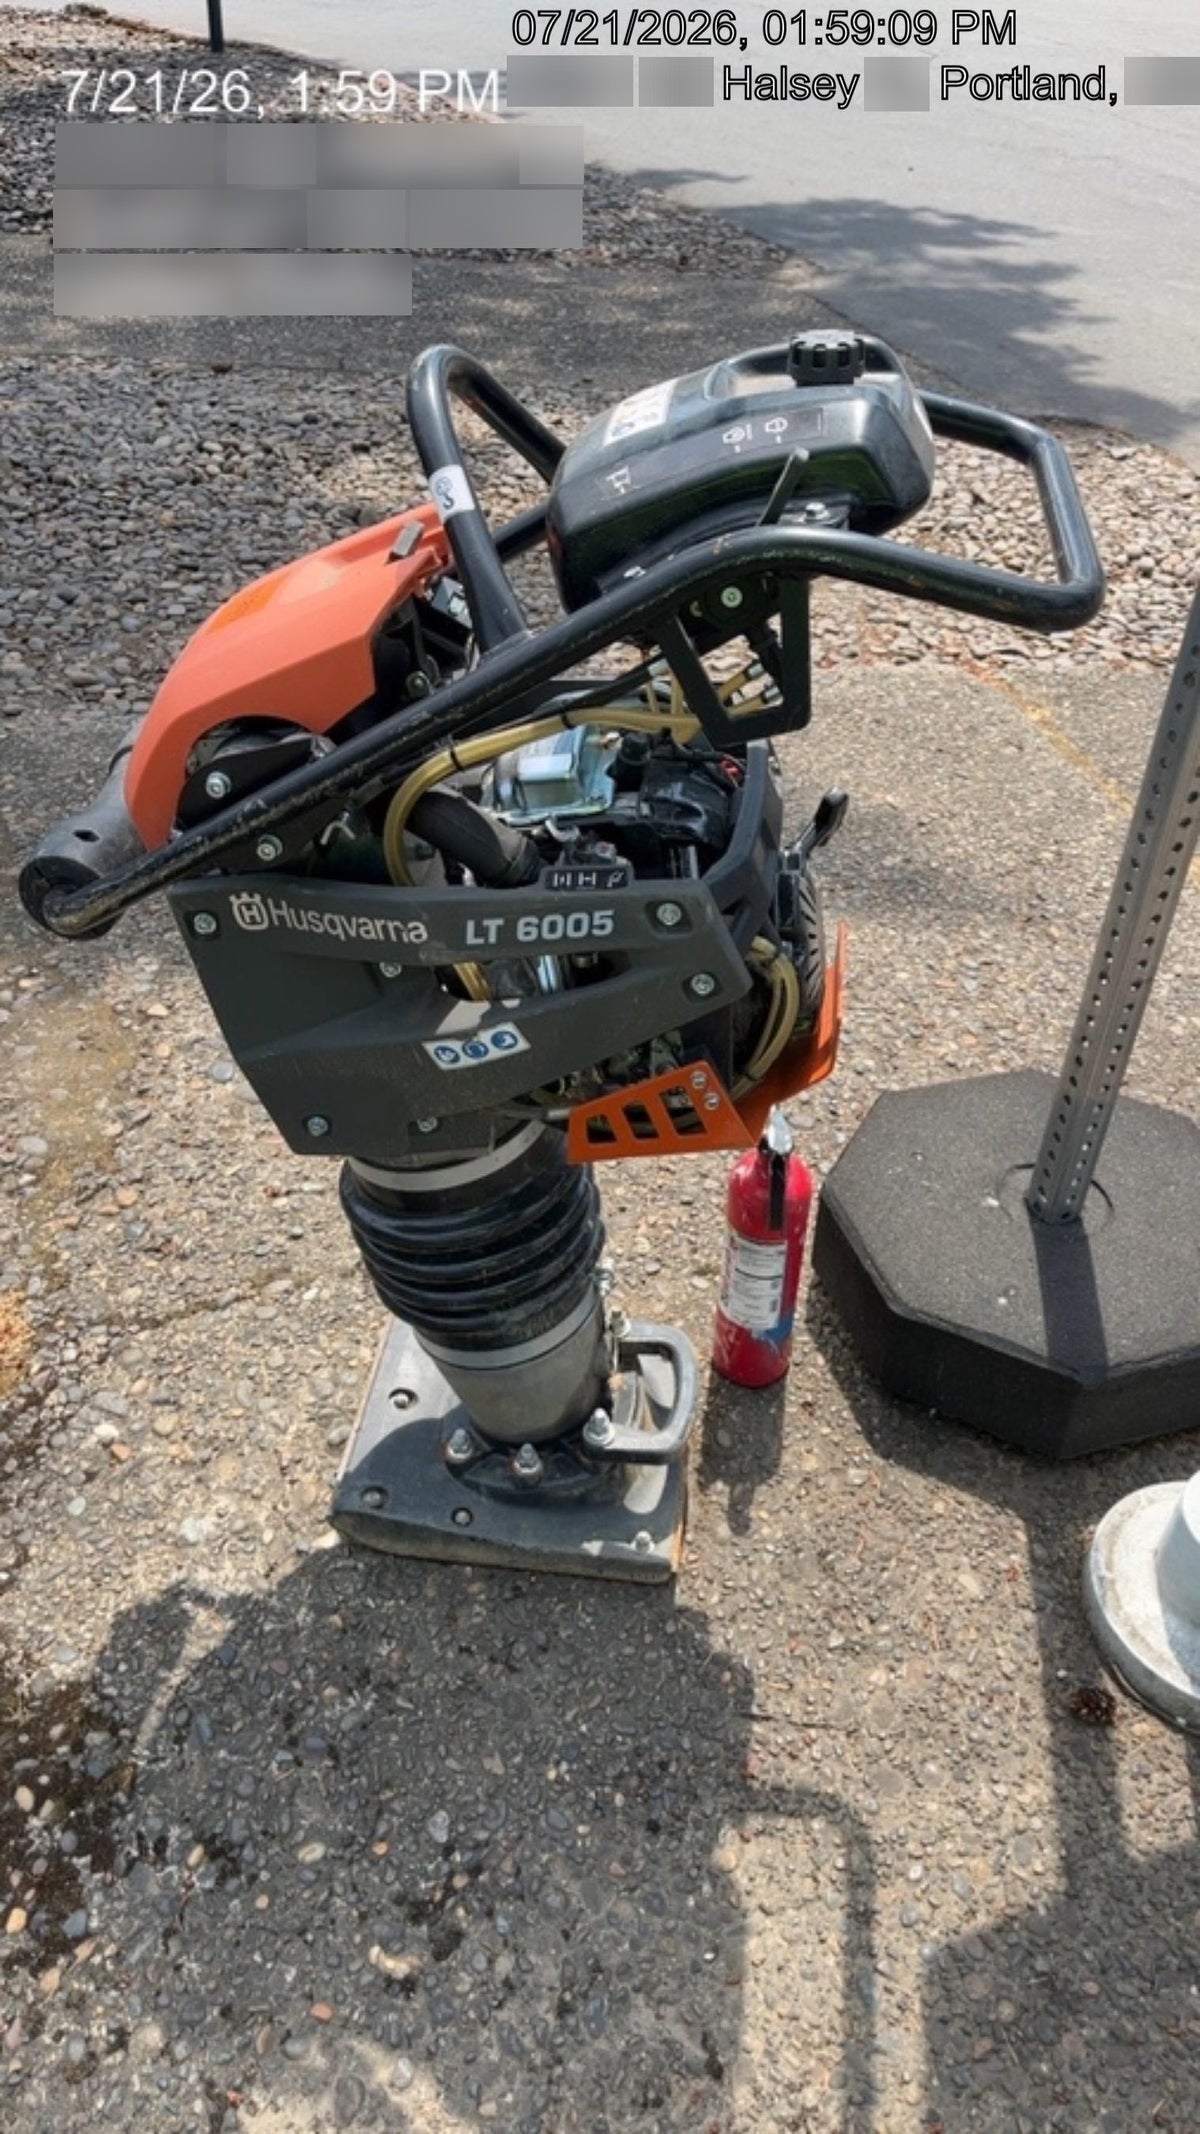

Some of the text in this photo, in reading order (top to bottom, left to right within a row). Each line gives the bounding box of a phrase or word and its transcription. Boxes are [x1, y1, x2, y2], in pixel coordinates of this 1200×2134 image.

[267, 898, 428, 944] Husqvarna
[466, 909, 615, 945] LT 6005
